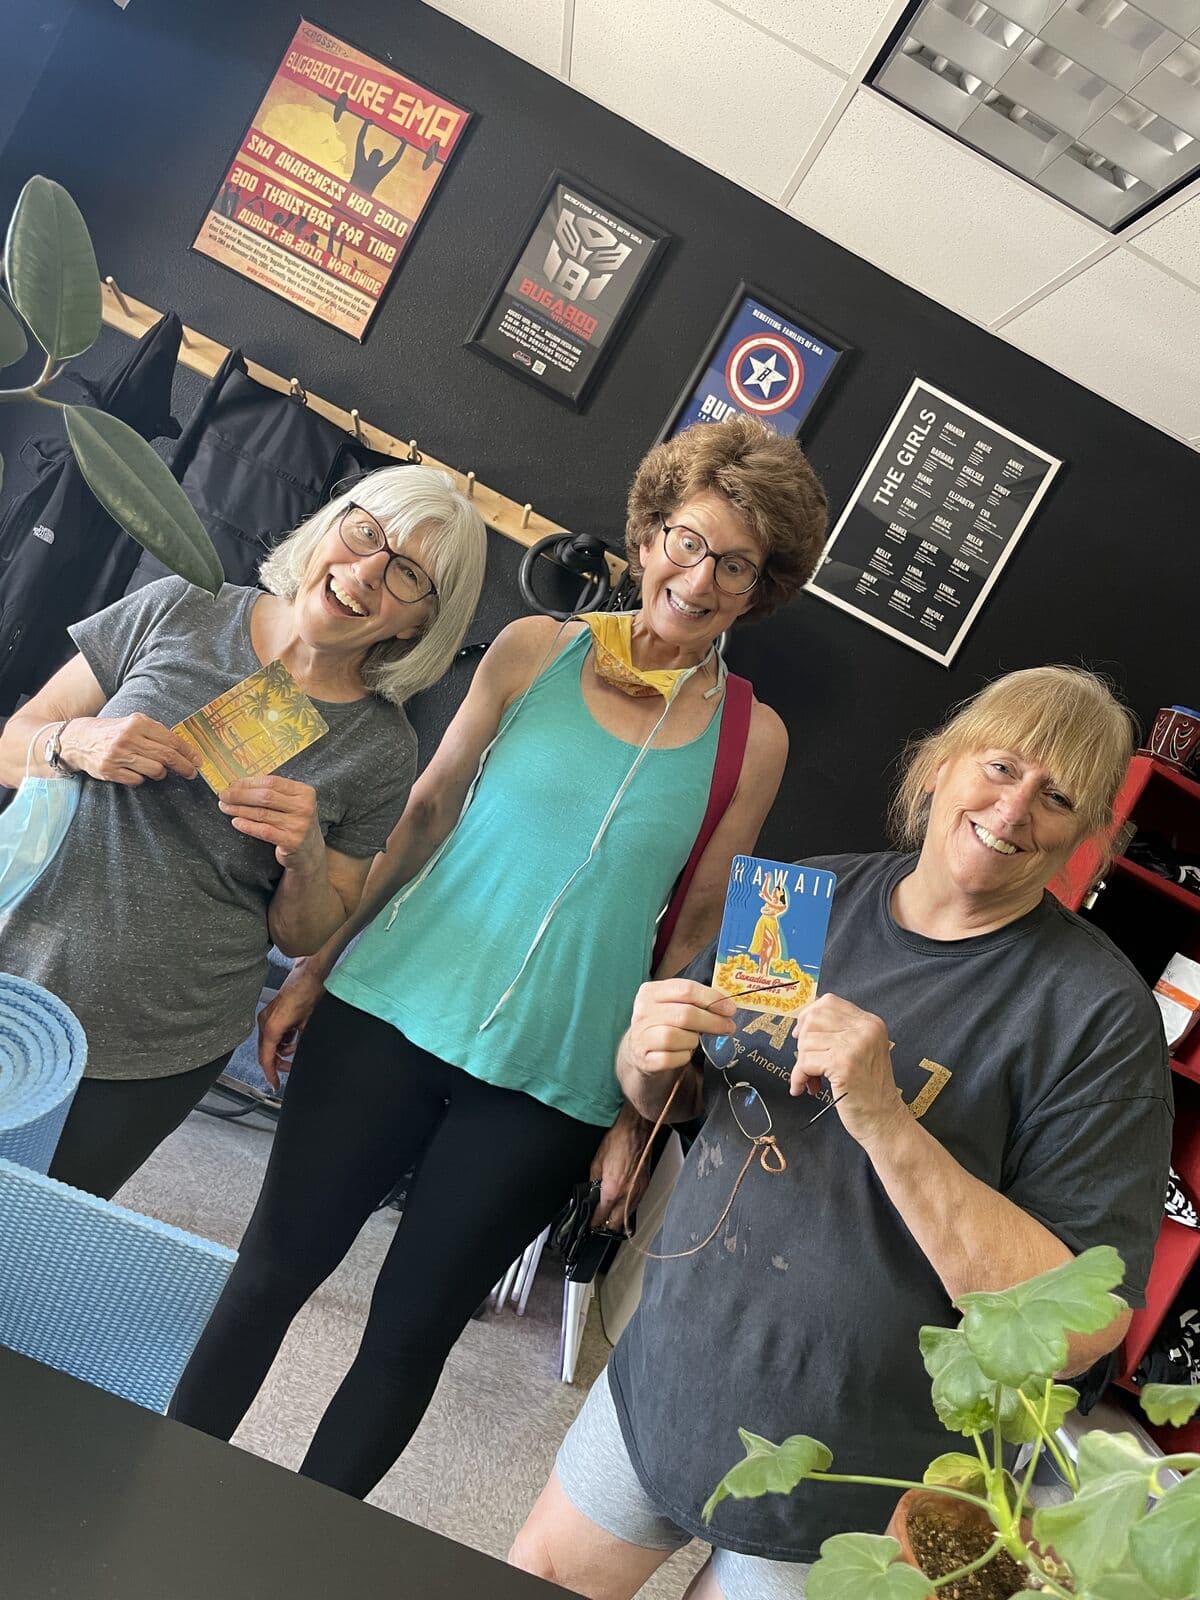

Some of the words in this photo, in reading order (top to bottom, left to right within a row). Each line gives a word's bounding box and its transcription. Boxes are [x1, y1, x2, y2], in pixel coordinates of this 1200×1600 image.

[287, 52, 340, 88] BUGABOO
[336, 72, 392, 114] CURE
[389, 93, 458, 146] SMA
[247, 135, 274, 159] SMA
[276, 153, 345, 200] AWARENESS
[374, 209, 408, 237] 2010
[263, 183, 334, 230] THRUSTERS
[336, 222, 364, 246] FOR
[327, 257, 381, 294] WORLDWIDE
[519, 278, 598, 332] BUGABOO
[873, 467, 905, 504] THE
[897, 409, 935, 465] GIRLS
[735, 862, 832, 898] HAWAII
[735, 972, 770, 986] Canadian
[746, 1050, 792, 1080] Americ
